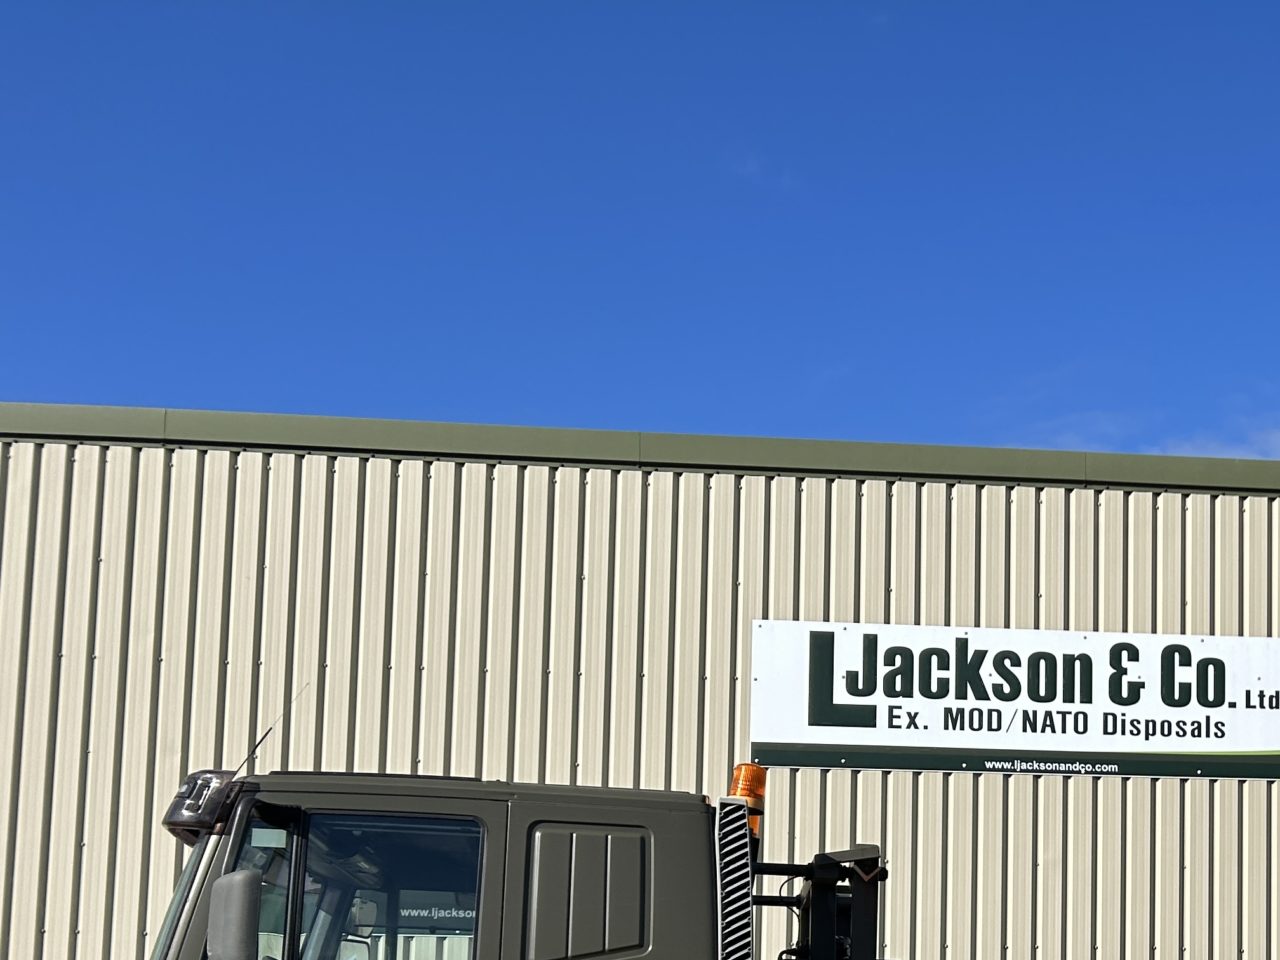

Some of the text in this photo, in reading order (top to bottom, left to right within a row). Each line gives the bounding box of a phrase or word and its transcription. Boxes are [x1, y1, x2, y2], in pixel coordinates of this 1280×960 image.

[1108, 642, 1146, 707] &
[1160, 643, 1237, 709] Co.
[888, 705, 1227, 741] Ex. MOD/NATO Disposals
[984, 759, 1119, 773] www.ljacksonandco.com
